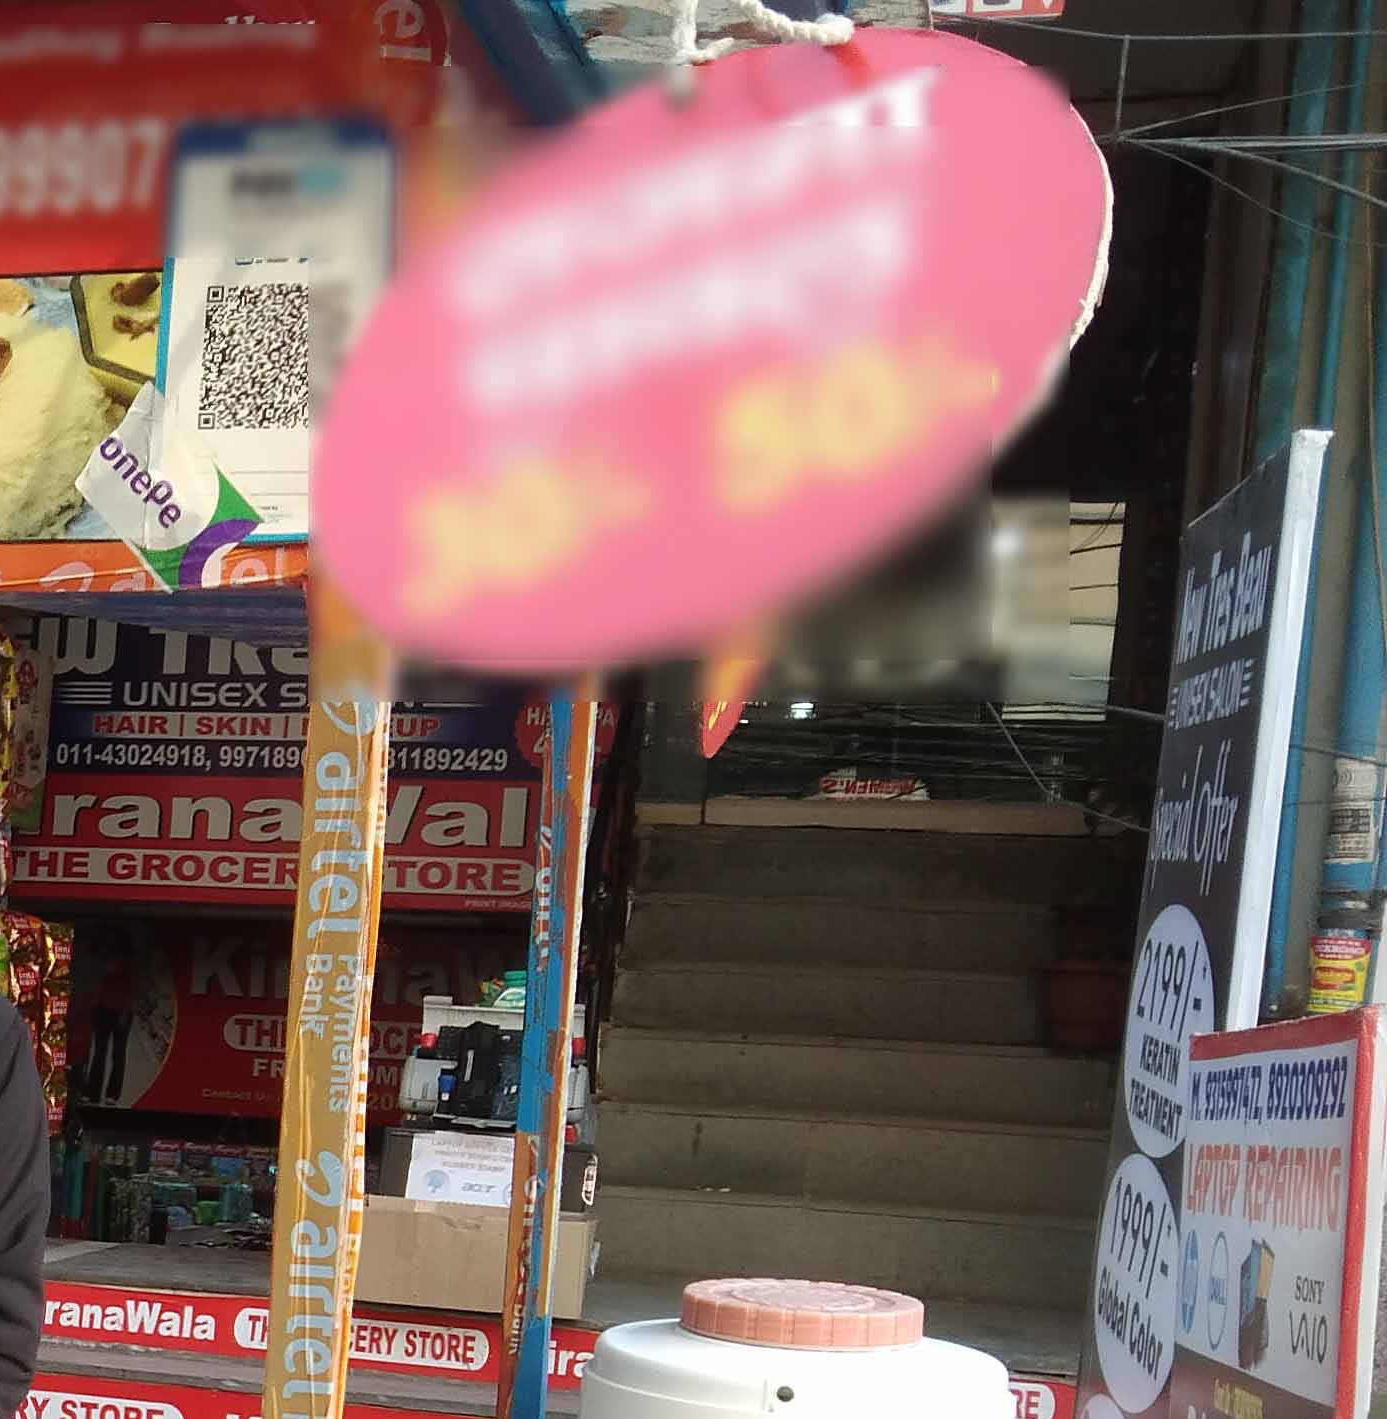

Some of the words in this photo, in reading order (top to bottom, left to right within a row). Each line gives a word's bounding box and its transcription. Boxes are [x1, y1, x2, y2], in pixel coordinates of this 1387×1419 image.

[93, 714, 168, 737] HAIR
[196, 714, 273, 738] SKIN
[123, 681, 268, 708] UNISEX
[306, 751, 374, 941] airtel
[1193, 738, 1239, 897] Offer
[121, 853, 301, 886] GROCER
[385, 860, 523, 892] TORE
[302, 952, 334, 1040] Bank
[328, 953, 363, 1114] Payments
[1139, 1033, 1181, 1088] KERATIN
[1129, 1076, 1184, 1143] TREATMENT
[1185, 1143, 1241, 1218] LAPTOP
[1243, 1145, 1342, 1233] REPAIRING
[282, 1220, 337, 1400] airtel
[1097, 1262, 1129, 1346] Global
[1128, 1299, 1165, 1382] Color
[1294, 1275, 1325, 1306] SONY
[44, 1298, 216, 1343] ranaWala
[403, 1328, 477, 1365] STORE
